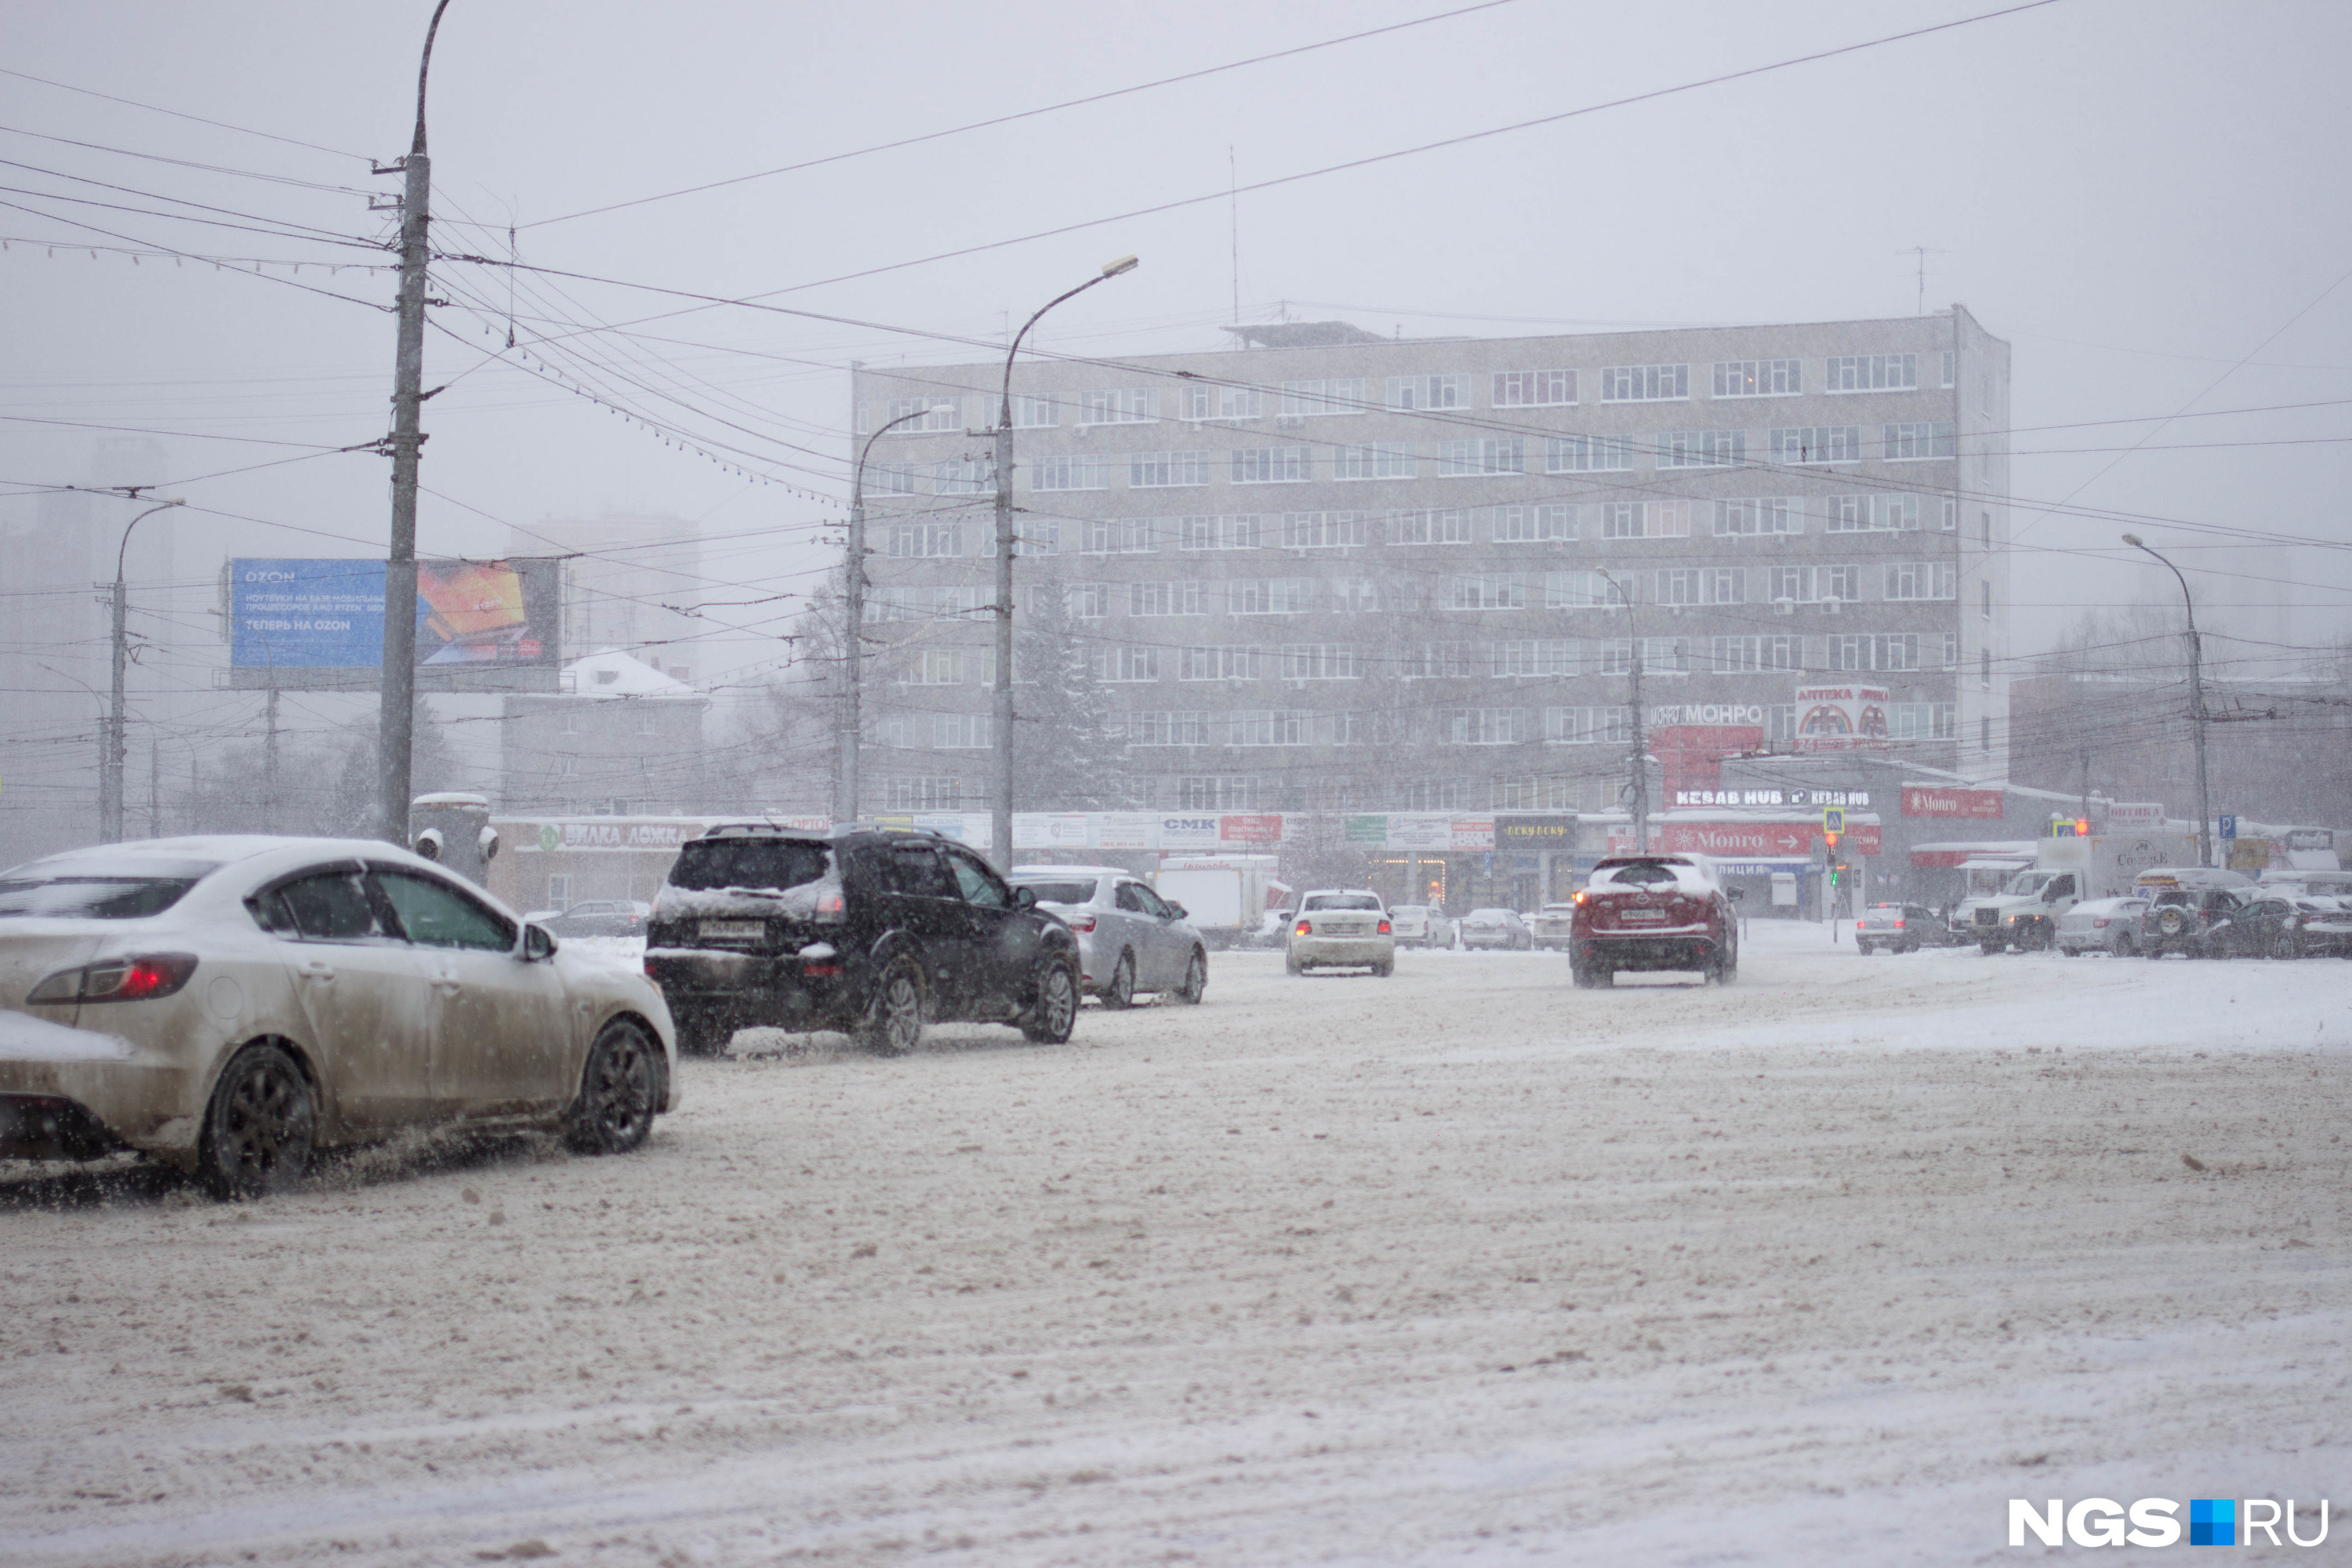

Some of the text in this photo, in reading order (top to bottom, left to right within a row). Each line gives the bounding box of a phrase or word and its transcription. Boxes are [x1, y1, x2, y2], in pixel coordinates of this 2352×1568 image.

[245, 572, 296, 583] OZON
[245, 620, 350, 630] ТЕПЕРЬ НА OZON
[1797, 688, 1853, 701] АПТЕКА
[1650, 706, 1680, 725] МОНРО
[1686, 704, 1763, 724] МОНРО
[1676, 790, 1783, 804] KEBAB HUB
[1811, 791, 1869, 805] KEBAB HUB
[1922, 794, 1957, 811] Monro
[1163, 818, 1215, 829] СМК
[565, 824, 688, 845] ВИЛКА ЛОЖКА
[1697, 832, 1763, 848] Monro
